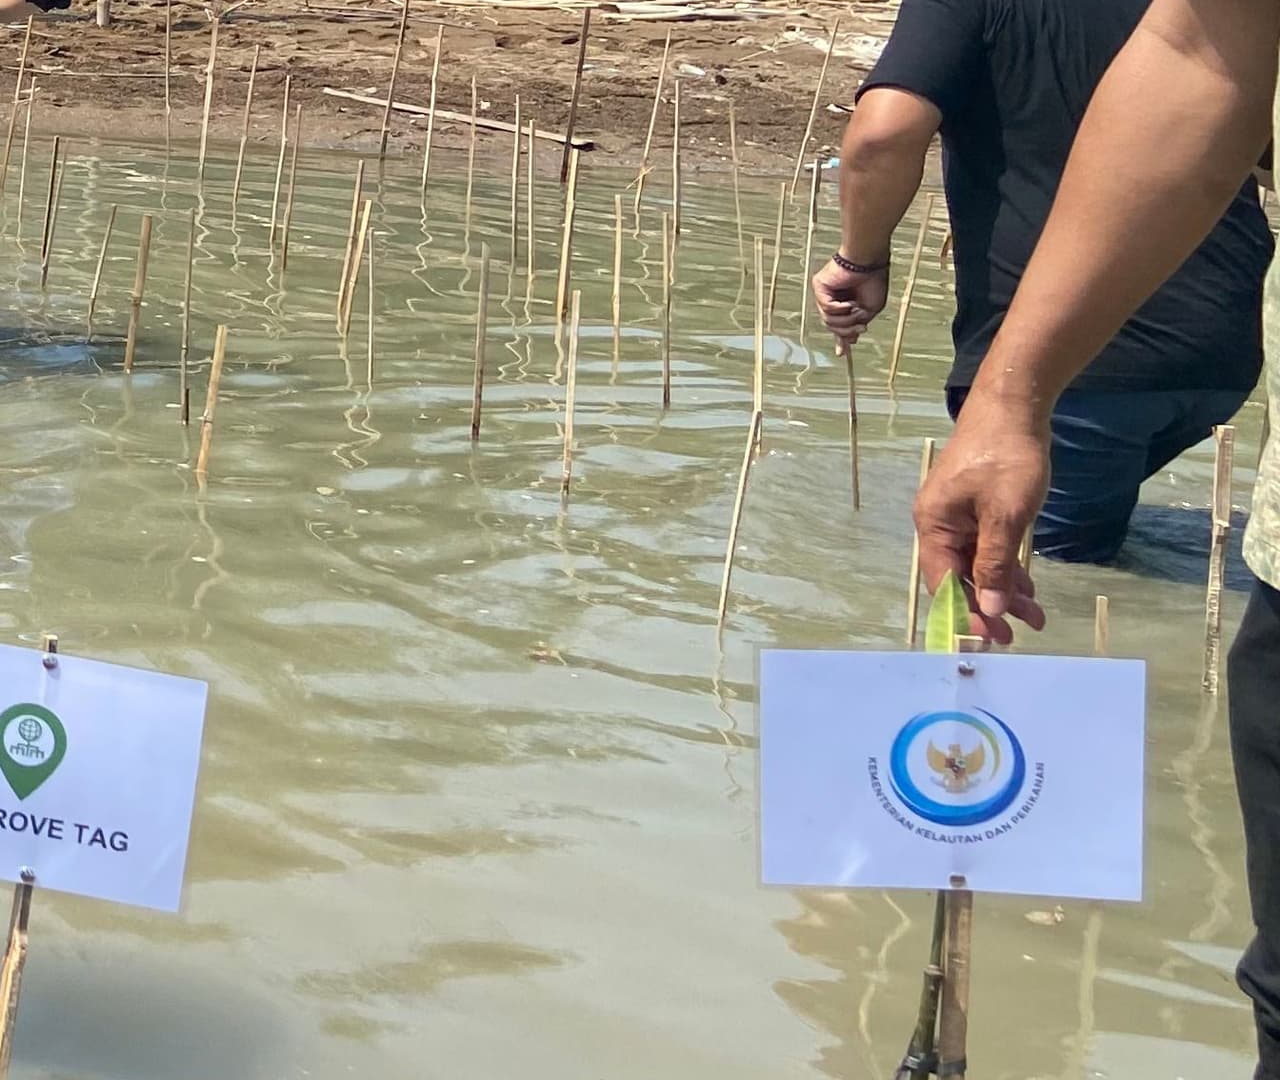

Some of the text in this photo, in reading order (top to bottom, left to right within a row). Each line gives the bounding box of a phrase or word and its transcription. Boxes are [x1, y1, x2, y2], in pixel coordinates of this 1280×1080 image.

[867, 756, 1045, 845] KEMENTERIAN KELAUTAN DAN PERIKANAN
[74, 822, 130, 853] TAG
